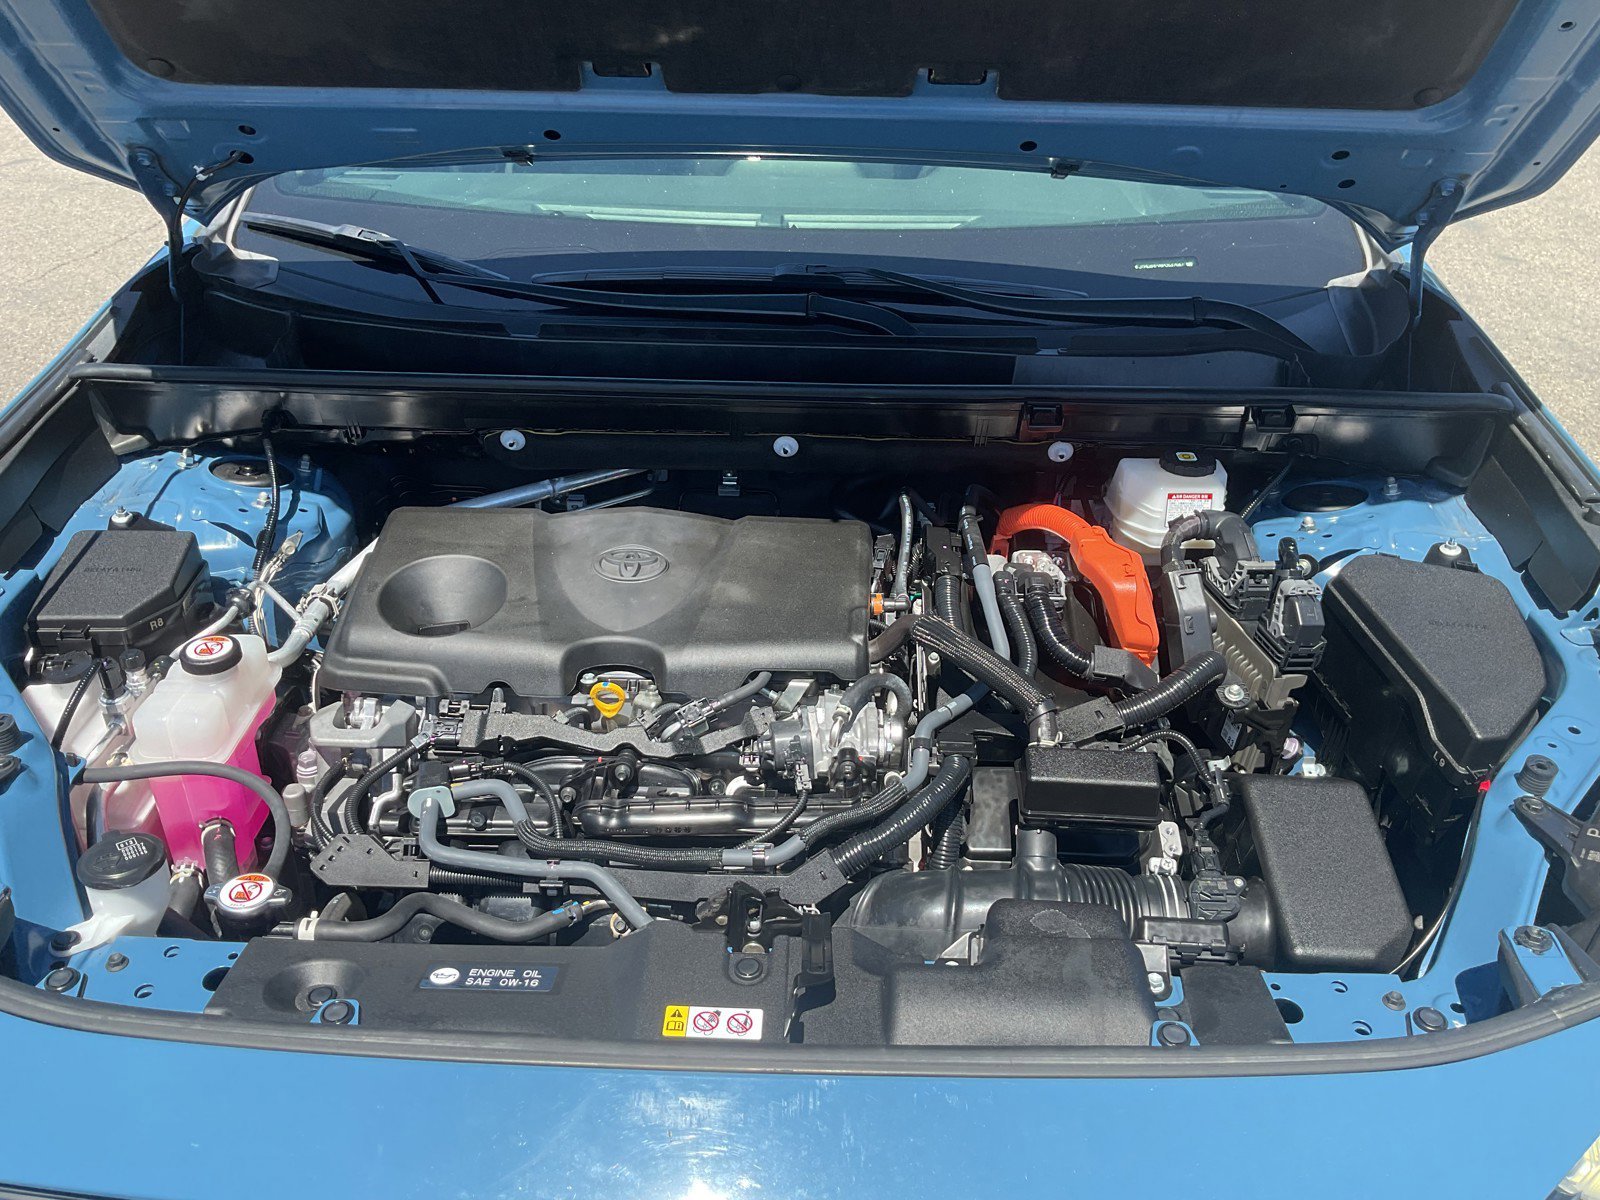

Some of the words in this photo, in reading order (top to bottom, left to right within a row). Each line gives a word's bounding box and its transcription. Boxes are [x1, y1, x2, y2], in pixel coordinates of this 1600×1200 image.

[149, 617, 165, 631] R8
[468, 968, 516, 977] ENGINE
[522, 969, 543, 978] OIL
[465, 977, 492, 986] SAE
[499, 978, 540, 987] 0W-16
